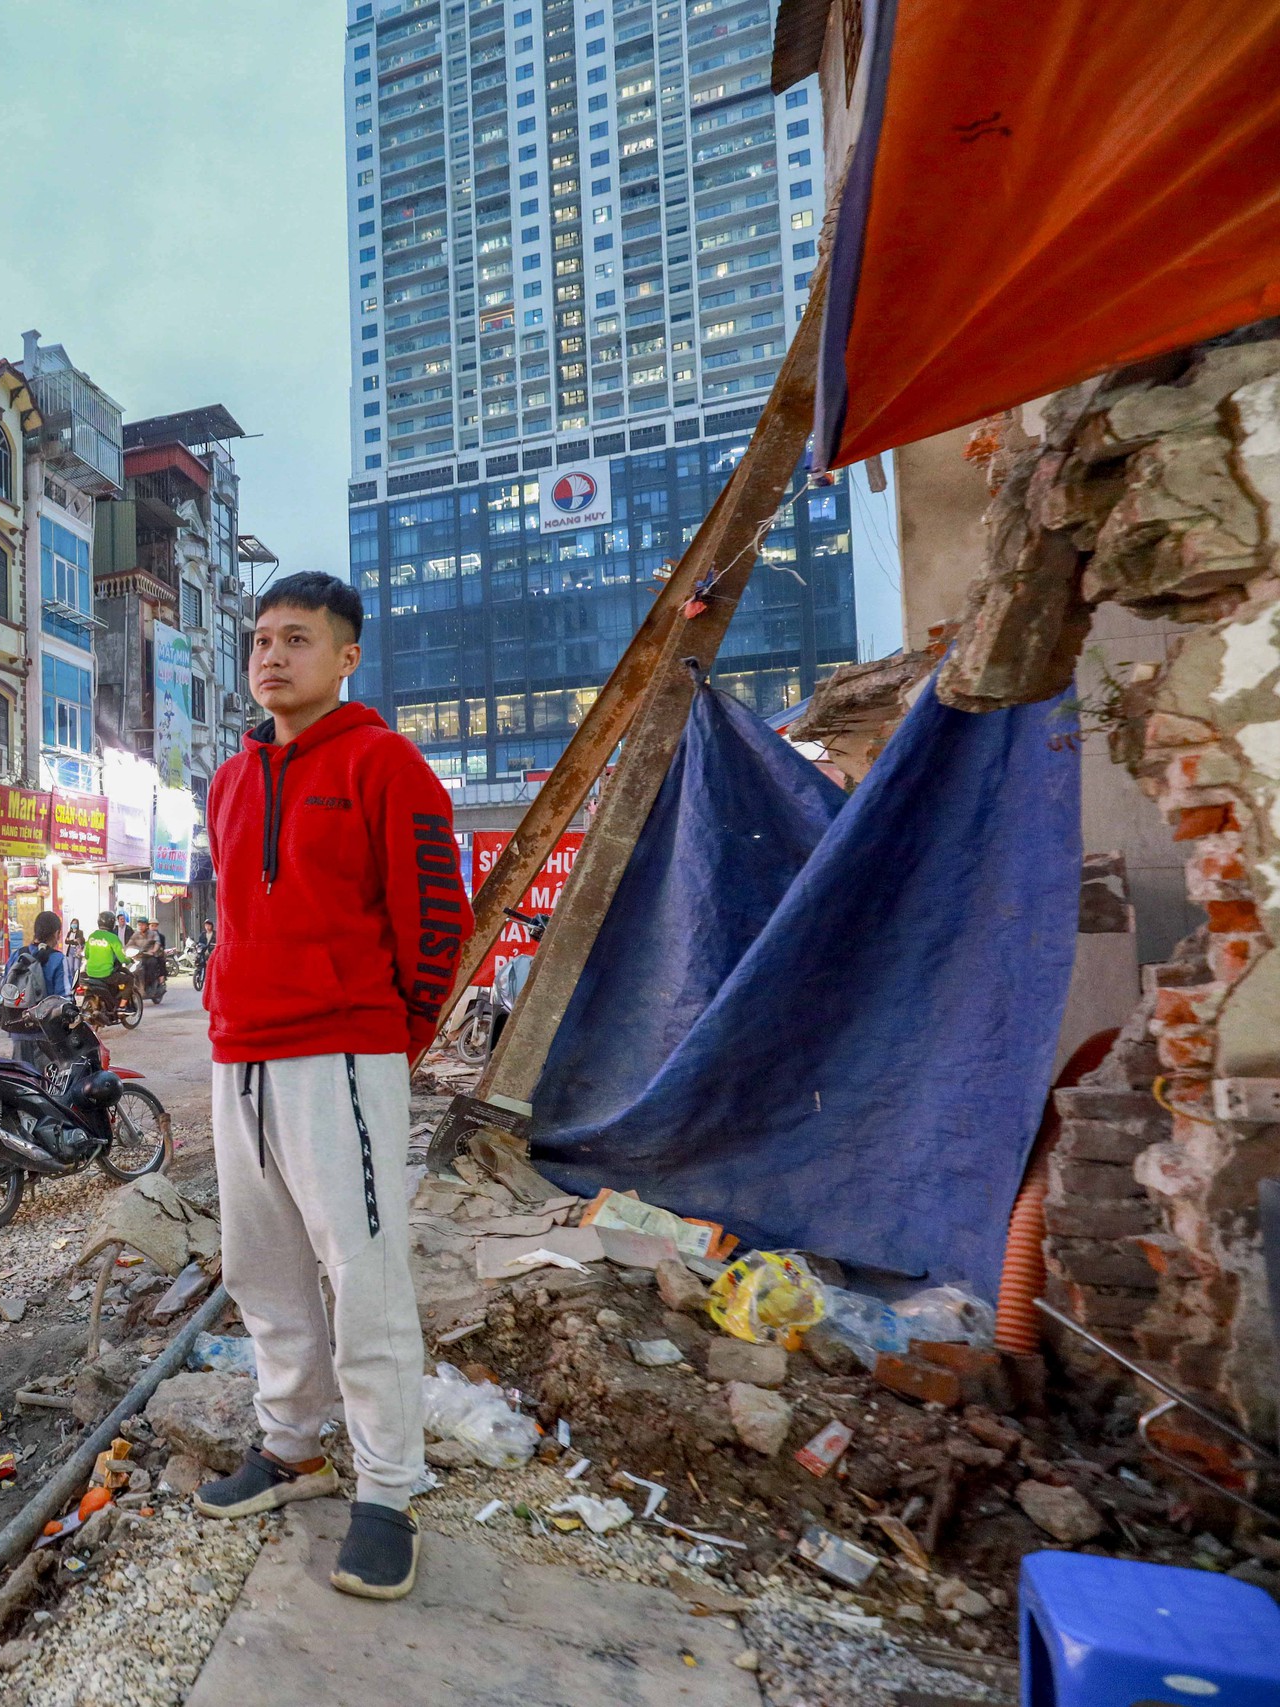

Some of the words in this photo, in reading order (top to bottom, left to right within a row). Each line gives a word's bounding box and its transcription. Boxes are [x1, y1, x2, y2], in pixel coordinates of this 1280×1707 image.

[7, 790, 37, 822] Mart
[411, 812, 463, 1024] HOLLISTER
[88, 937, 108, 948] Grab
